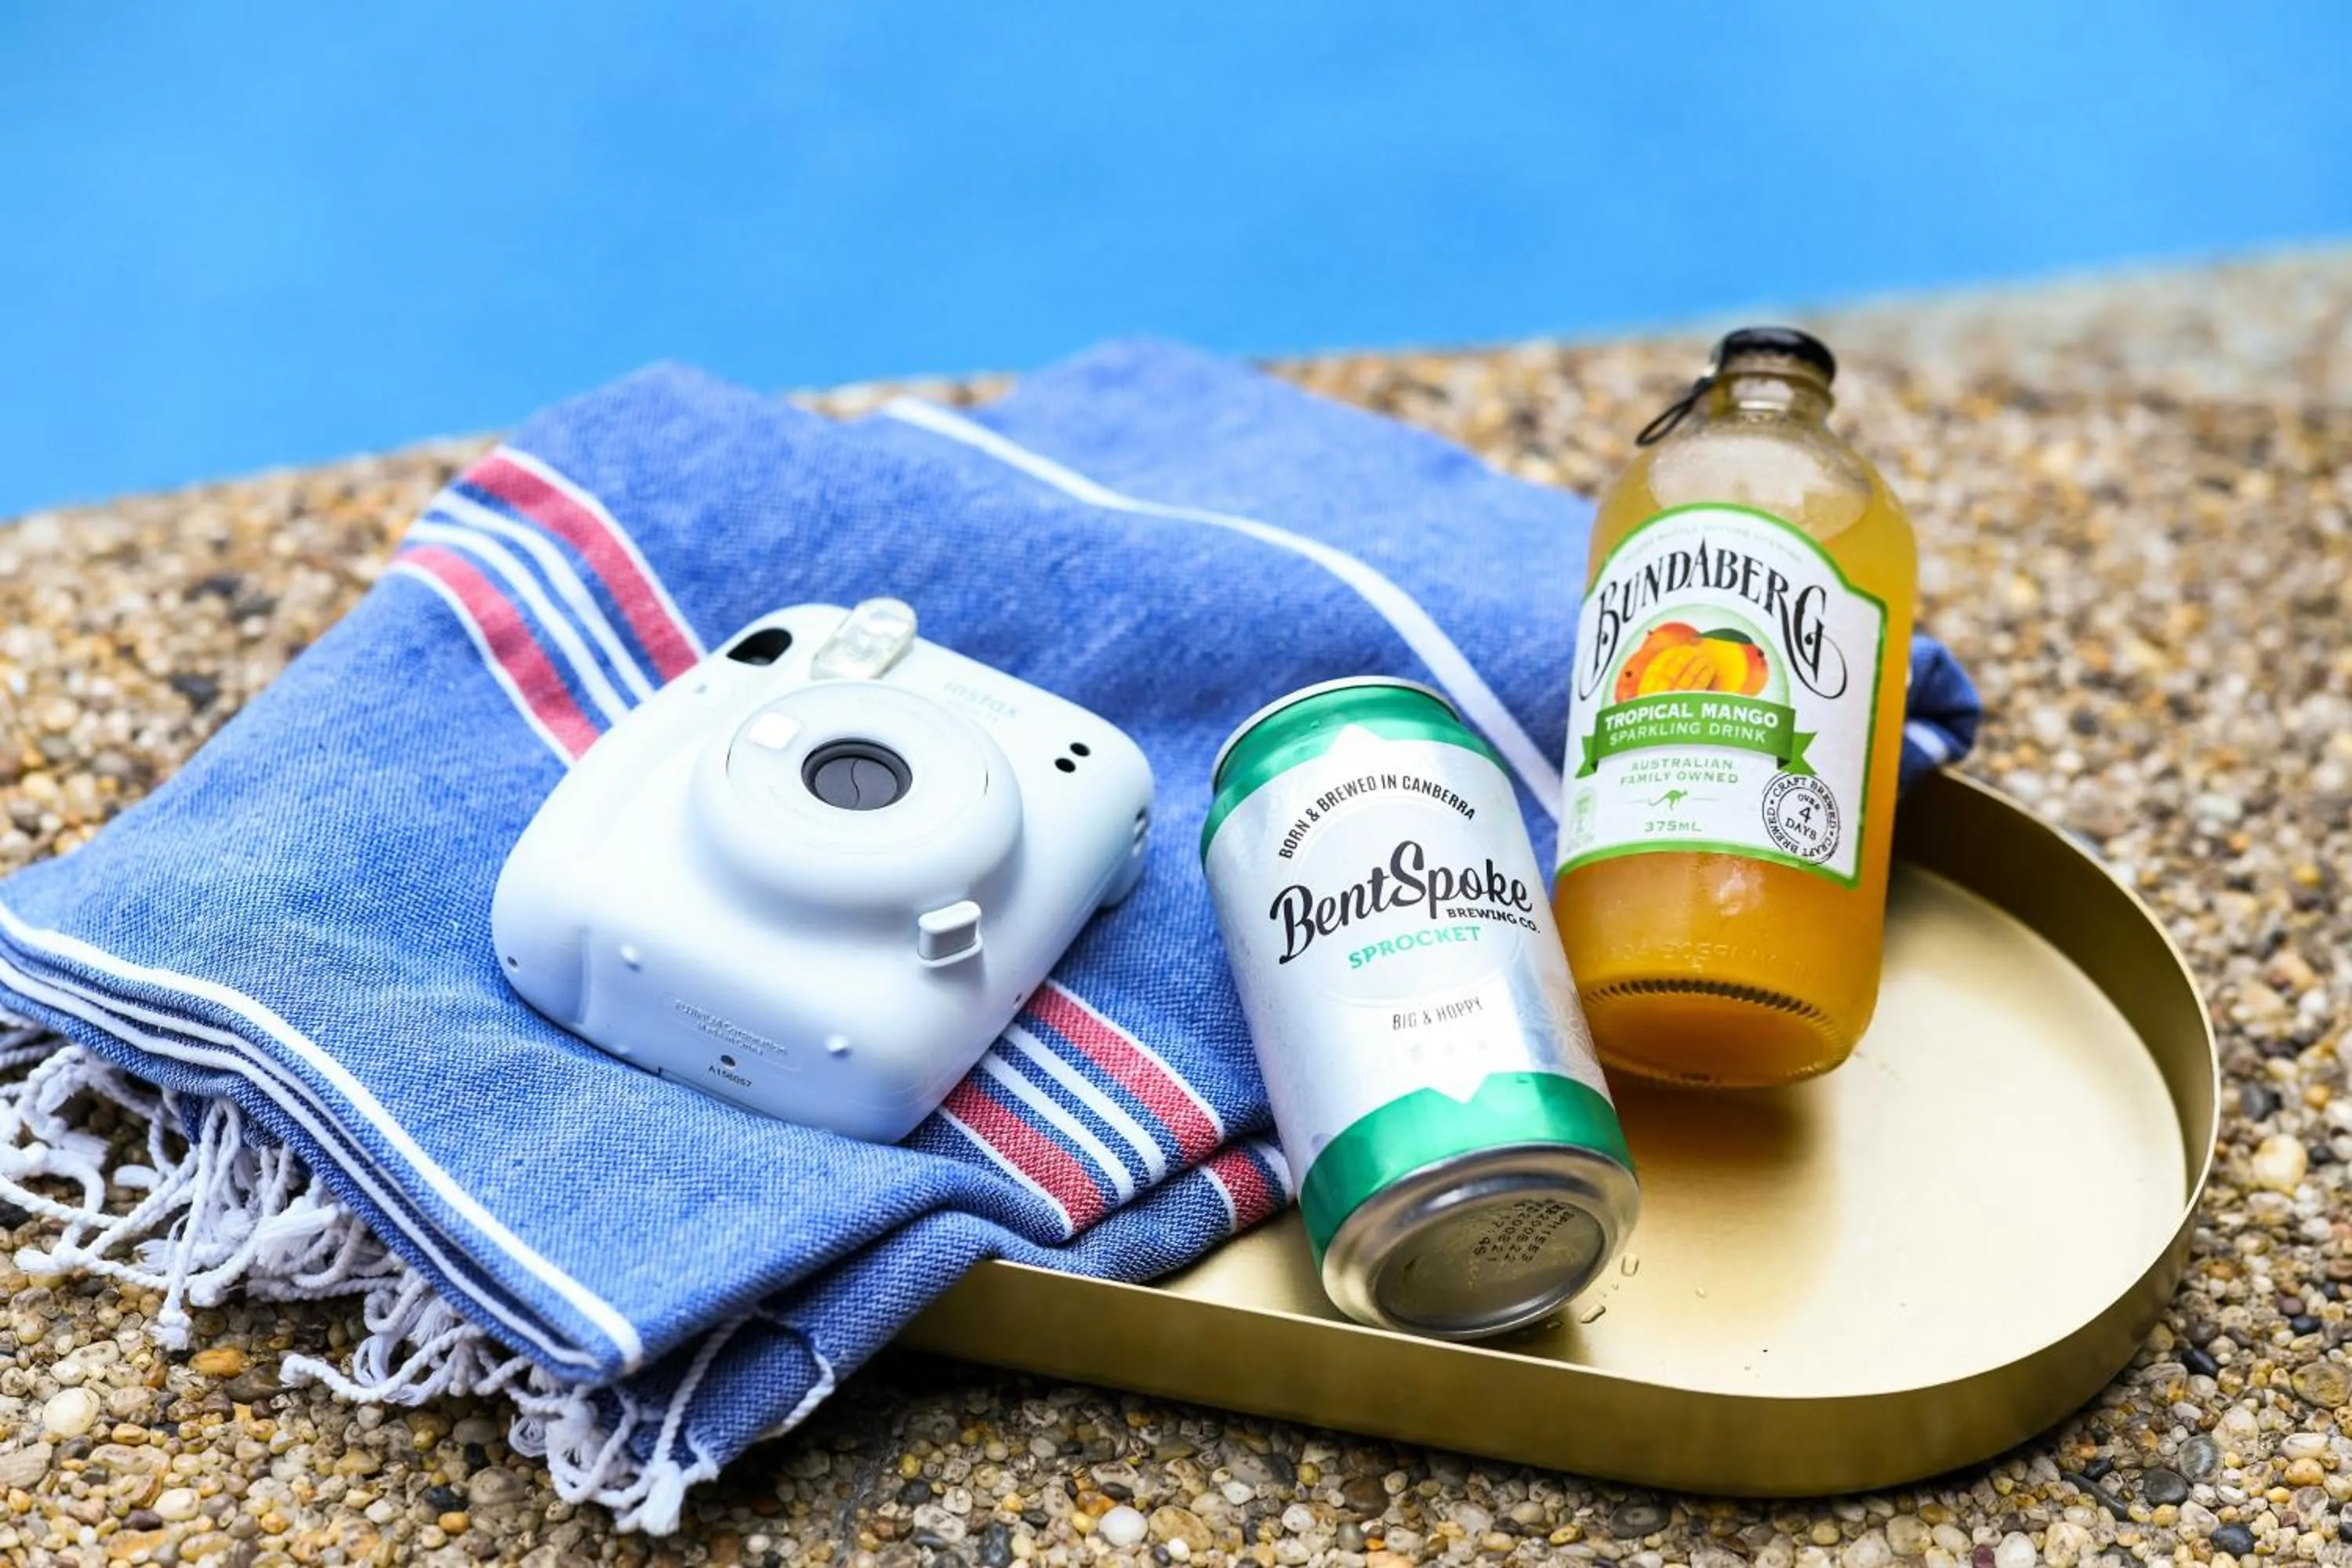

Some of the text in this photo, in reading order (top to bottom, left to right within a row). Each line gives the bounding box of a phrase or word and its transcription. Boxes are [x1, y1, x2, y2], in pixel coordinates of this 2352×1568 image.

[1578, 534, 1847, 700] BUNDABERG
[1605, 702, 1779, 731] TROPICAL MANGO
[1609, 722, 1766, 746] SPARKLING DRINK
[1620, 771, 1738, 786] FAMILY OWNED
[1631, 758, 1733, 771] AUSTRALIAN
[1279, 774, 1475, 858] BORN & BREWED IN CANBERRA
[1773, 777, 1837, 829] CRAFT BREWED
[1798, 807, 1813, 823] 4
[1644, 821, 1702, 833] 375ML
[1785, 818, 1817, 840] DAYS
[1269, 840, 1533, 964] BentSpoke
[1446, 907, 1541, 934] BREWING CO.
[1348, 925, 1482, 970] SPROCKET
[1392, 997, 1483, 1031] BIG & HOPPY
